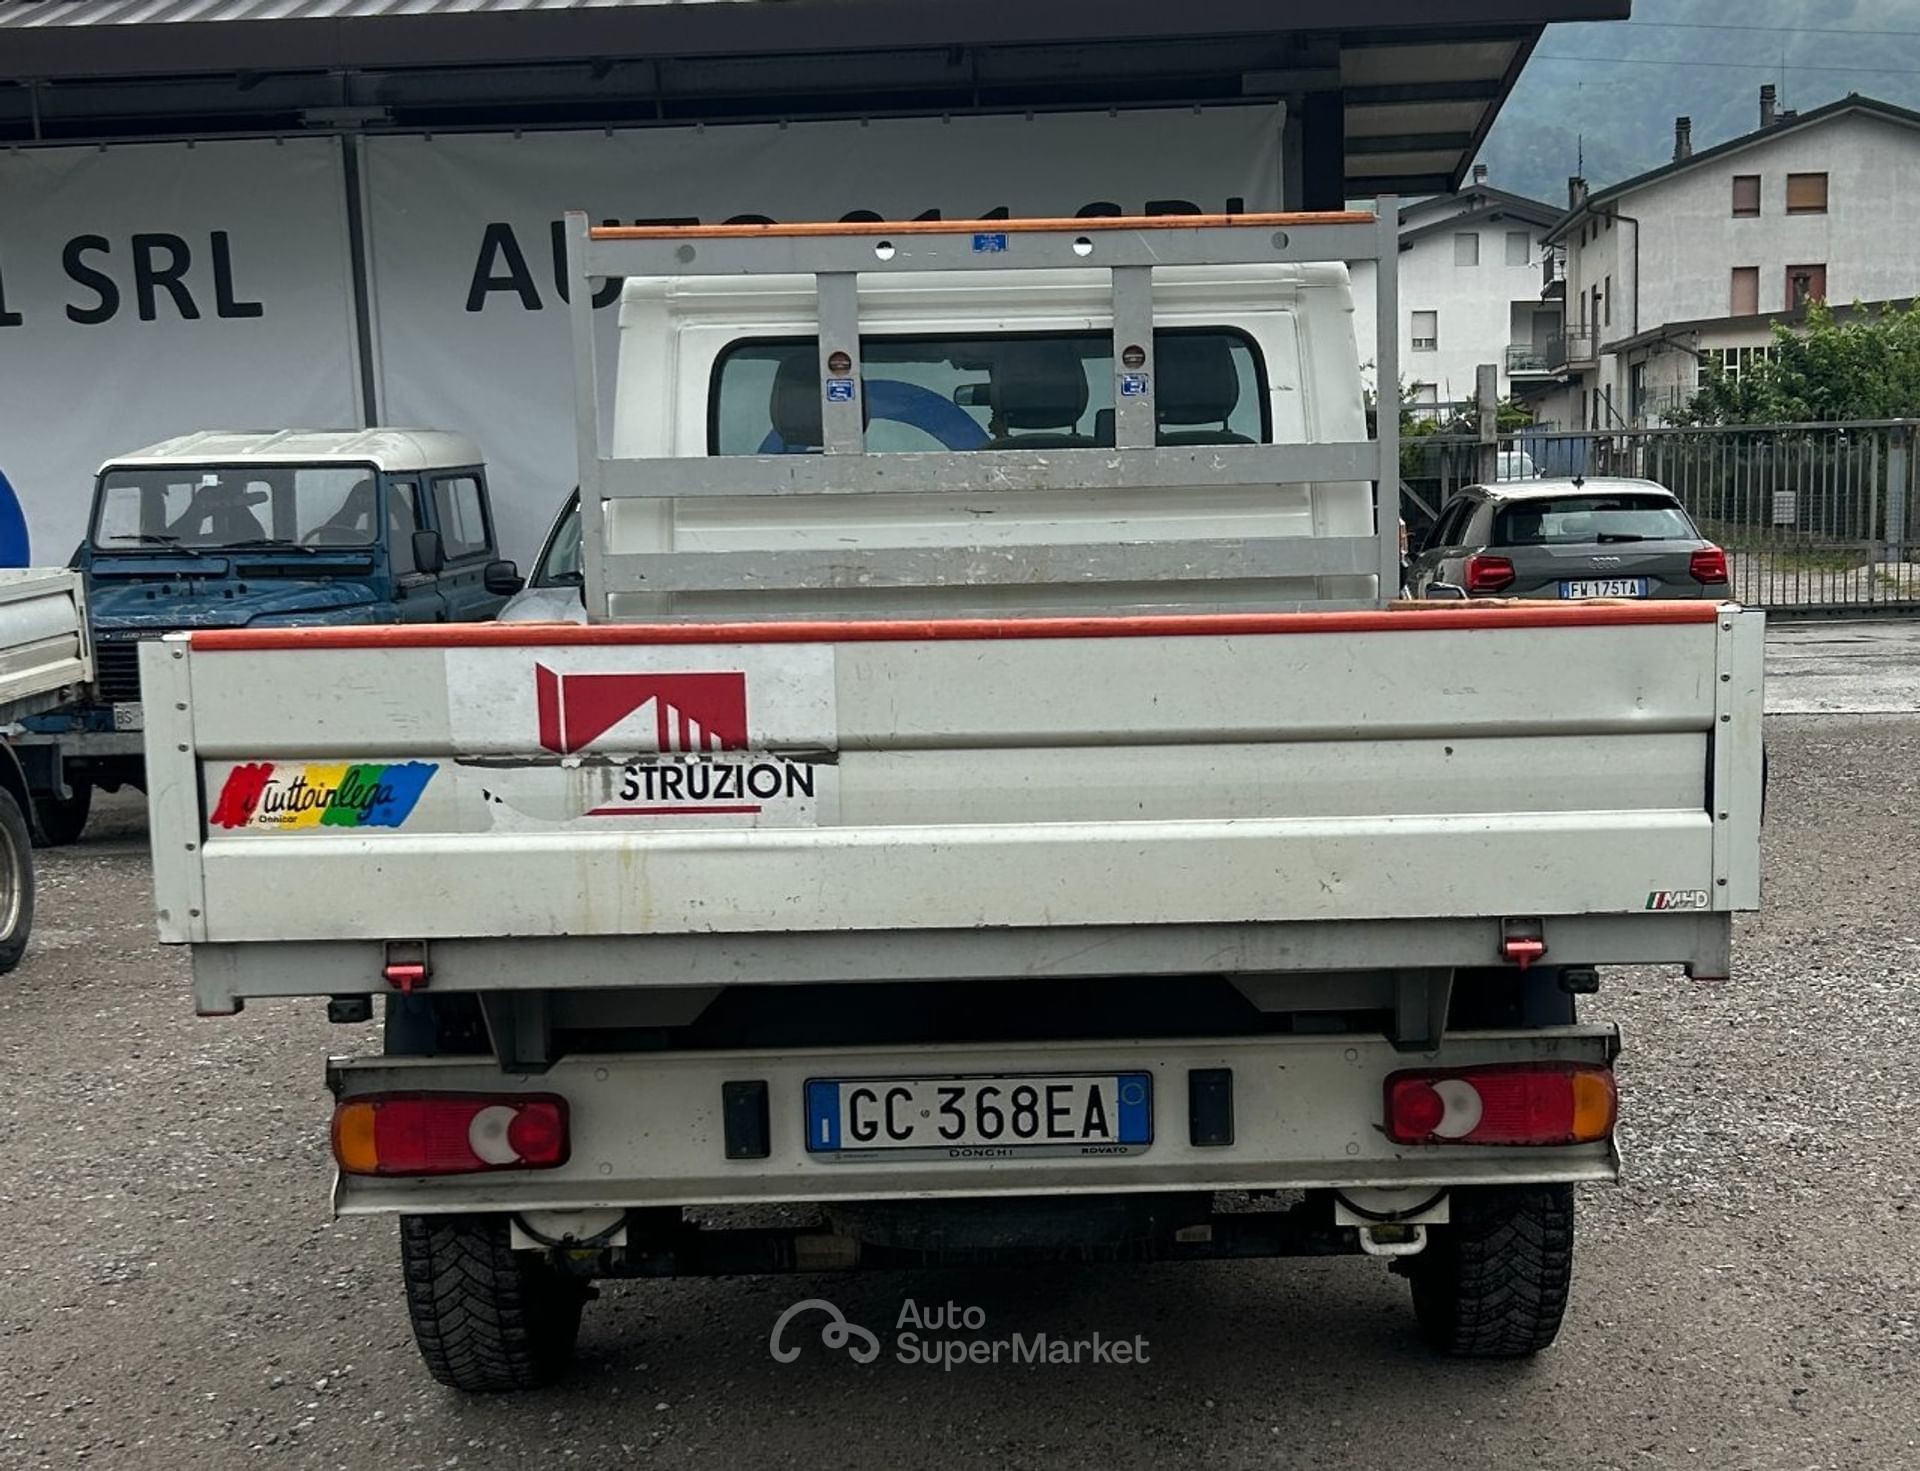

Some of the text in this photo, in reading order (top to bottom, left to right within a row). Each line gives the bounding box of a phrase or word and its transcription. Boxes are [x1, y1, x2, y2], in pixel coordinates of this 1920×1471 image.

[62, 231, 263, 324] SRL
[1571, 582, 1588, 597] FW
[1594, 581, 1637, 596] 175TA
[619, 763, 814, 800] STRUZION
[849, 1087, 914, 1142] GC
[937, 1084, 1109, 1140] 368EA
[949, 1146, 1128, 1158] DONGHI ROVATO
